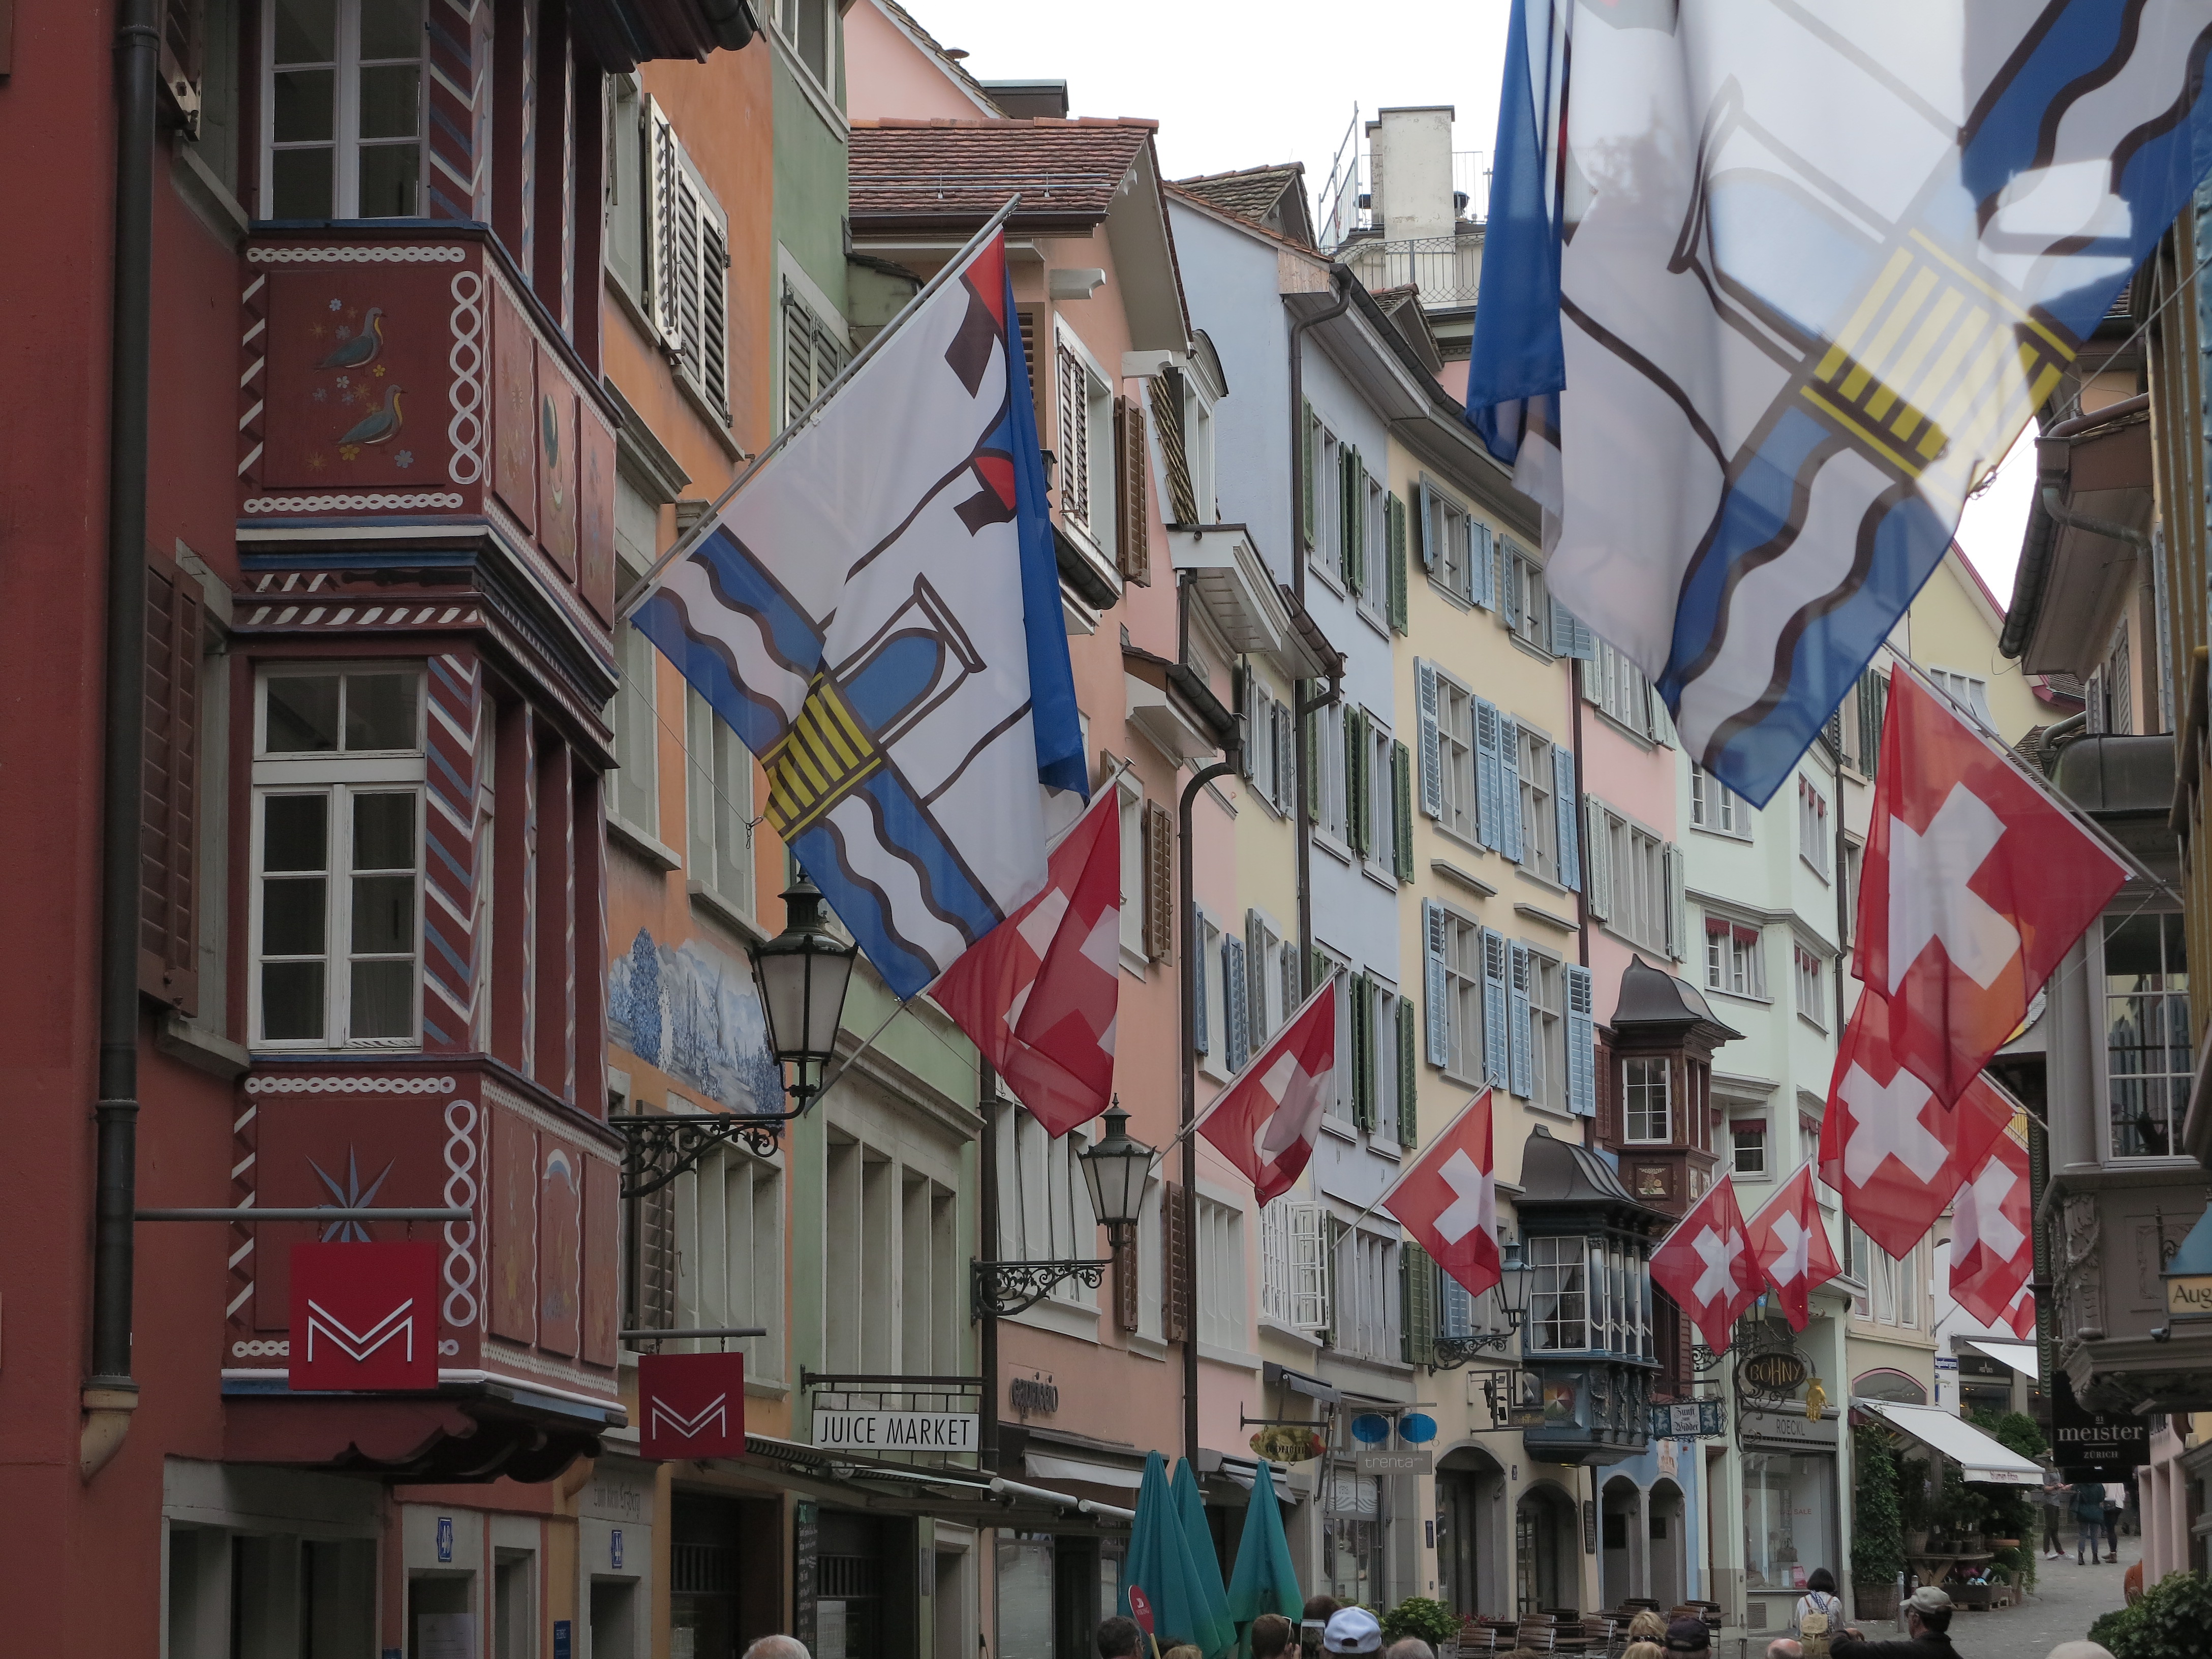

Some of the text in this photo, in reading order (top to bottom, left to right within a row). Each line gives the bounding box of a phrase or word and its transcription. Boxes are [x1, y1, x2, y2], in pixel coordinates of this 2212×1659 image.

[2172, 1284, 2212, 1308] Aug
[820, 1417, 970, 1446] JUICE MARKET
[1673, 1421, 1698, 1431] Widder
[1776, 1419, 1805, 1436] ROECKL
[2057, 1425, 2143, 1441] meister
[1365, 1457, 1414, 1468] trenta
[2084, 1451, 2118, 1459] ZÜRICH
